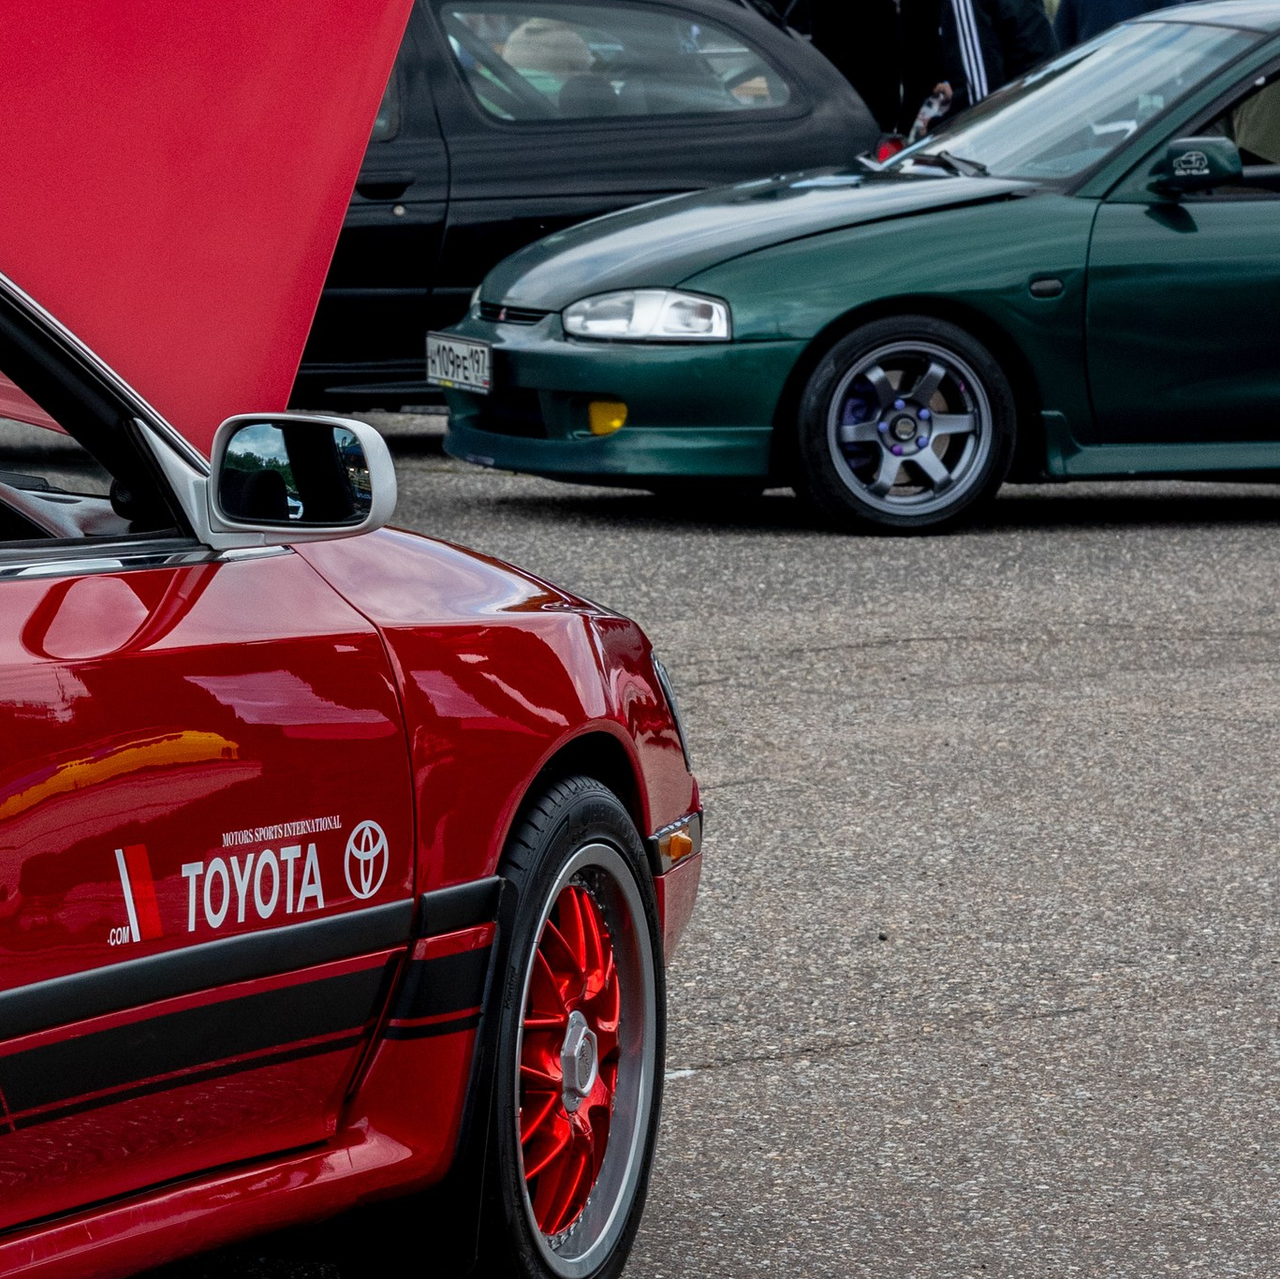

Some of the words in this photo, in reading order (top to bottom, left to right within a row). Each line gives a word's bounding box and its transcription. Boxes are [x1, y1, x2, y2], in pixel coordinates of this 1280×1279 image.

[470, 348, 486, 374] 197
[222, 828, 254, 847] MOTORS
[254, 823, 283, 842] SPORTS
[283, 815, 342, 838] INTERNATIONAL
[181, 843, 325, 932] TOYOTA
[107, 925, 130, 946] .COM
